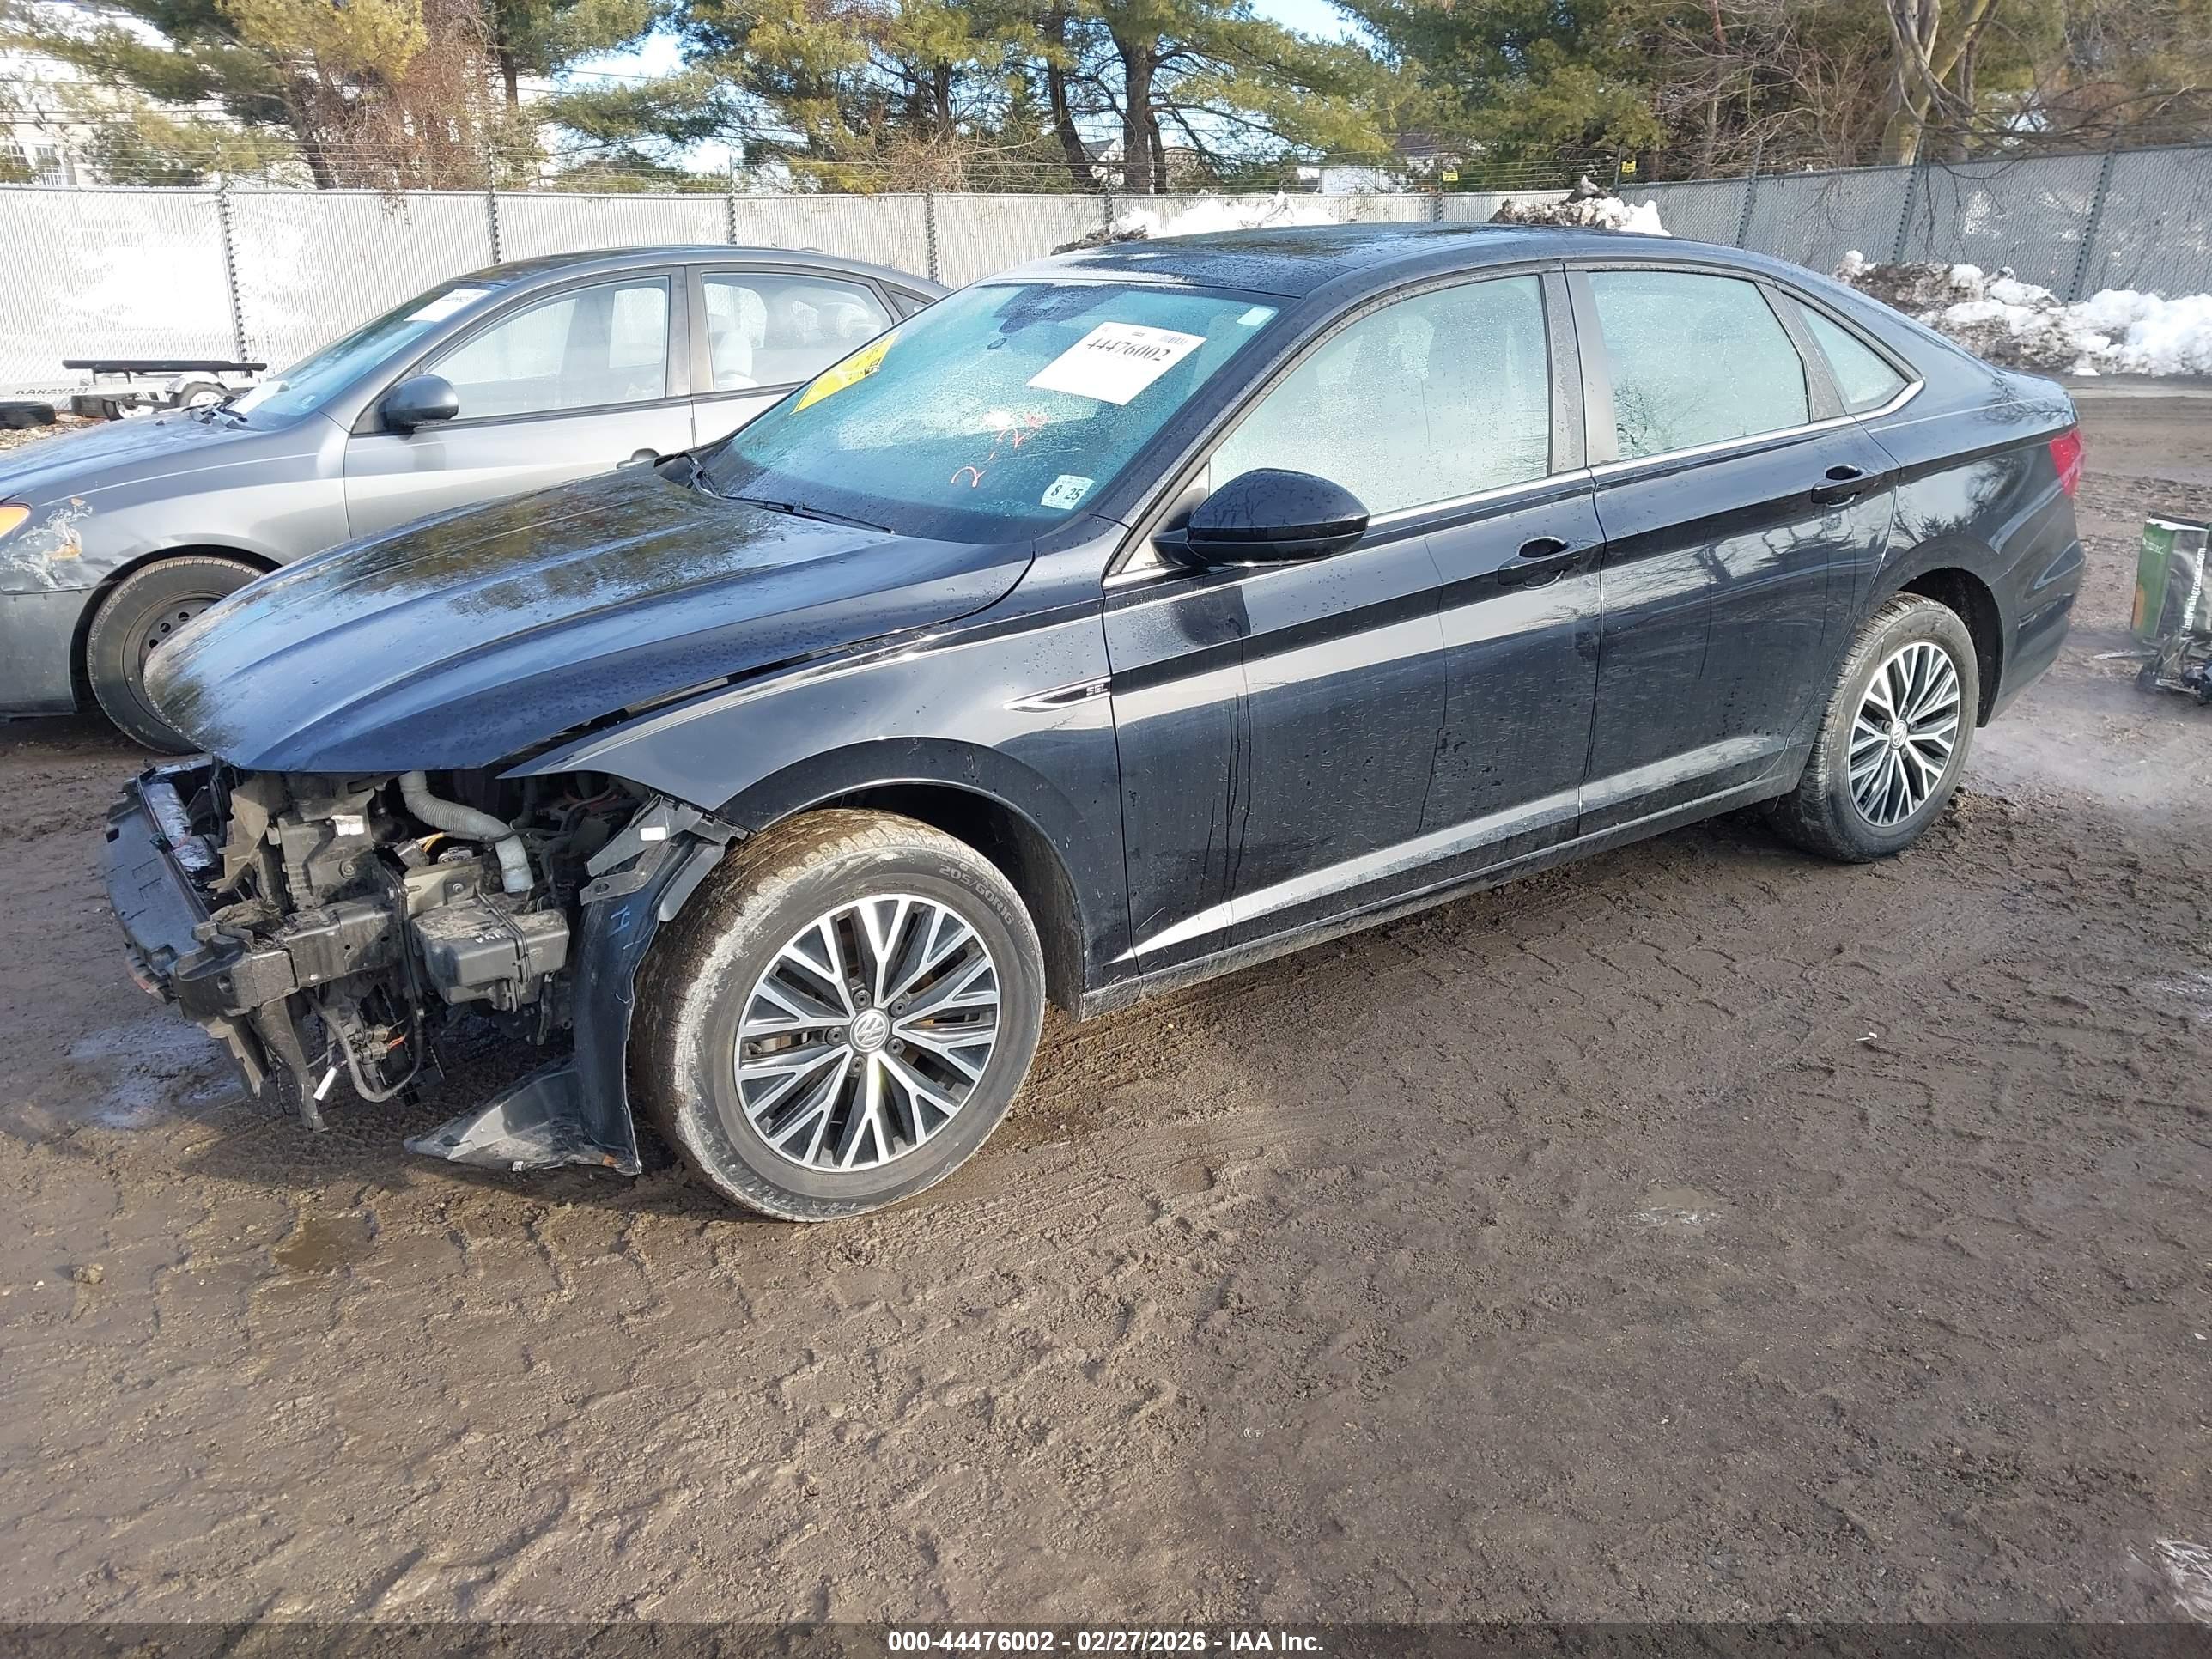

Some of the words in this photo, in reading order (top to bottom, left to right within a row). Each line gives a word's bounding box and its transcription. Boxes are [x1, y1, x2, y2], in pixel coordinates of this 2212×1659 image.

[1086, 337, 1171, 362] 44476002
[1050, 484, 1064, 497] 8
[1065, 487, 1085, 501] 25
[1085, 684, 1109, 696] SEL
[938, 864, 1015, 926] 205/60R16
